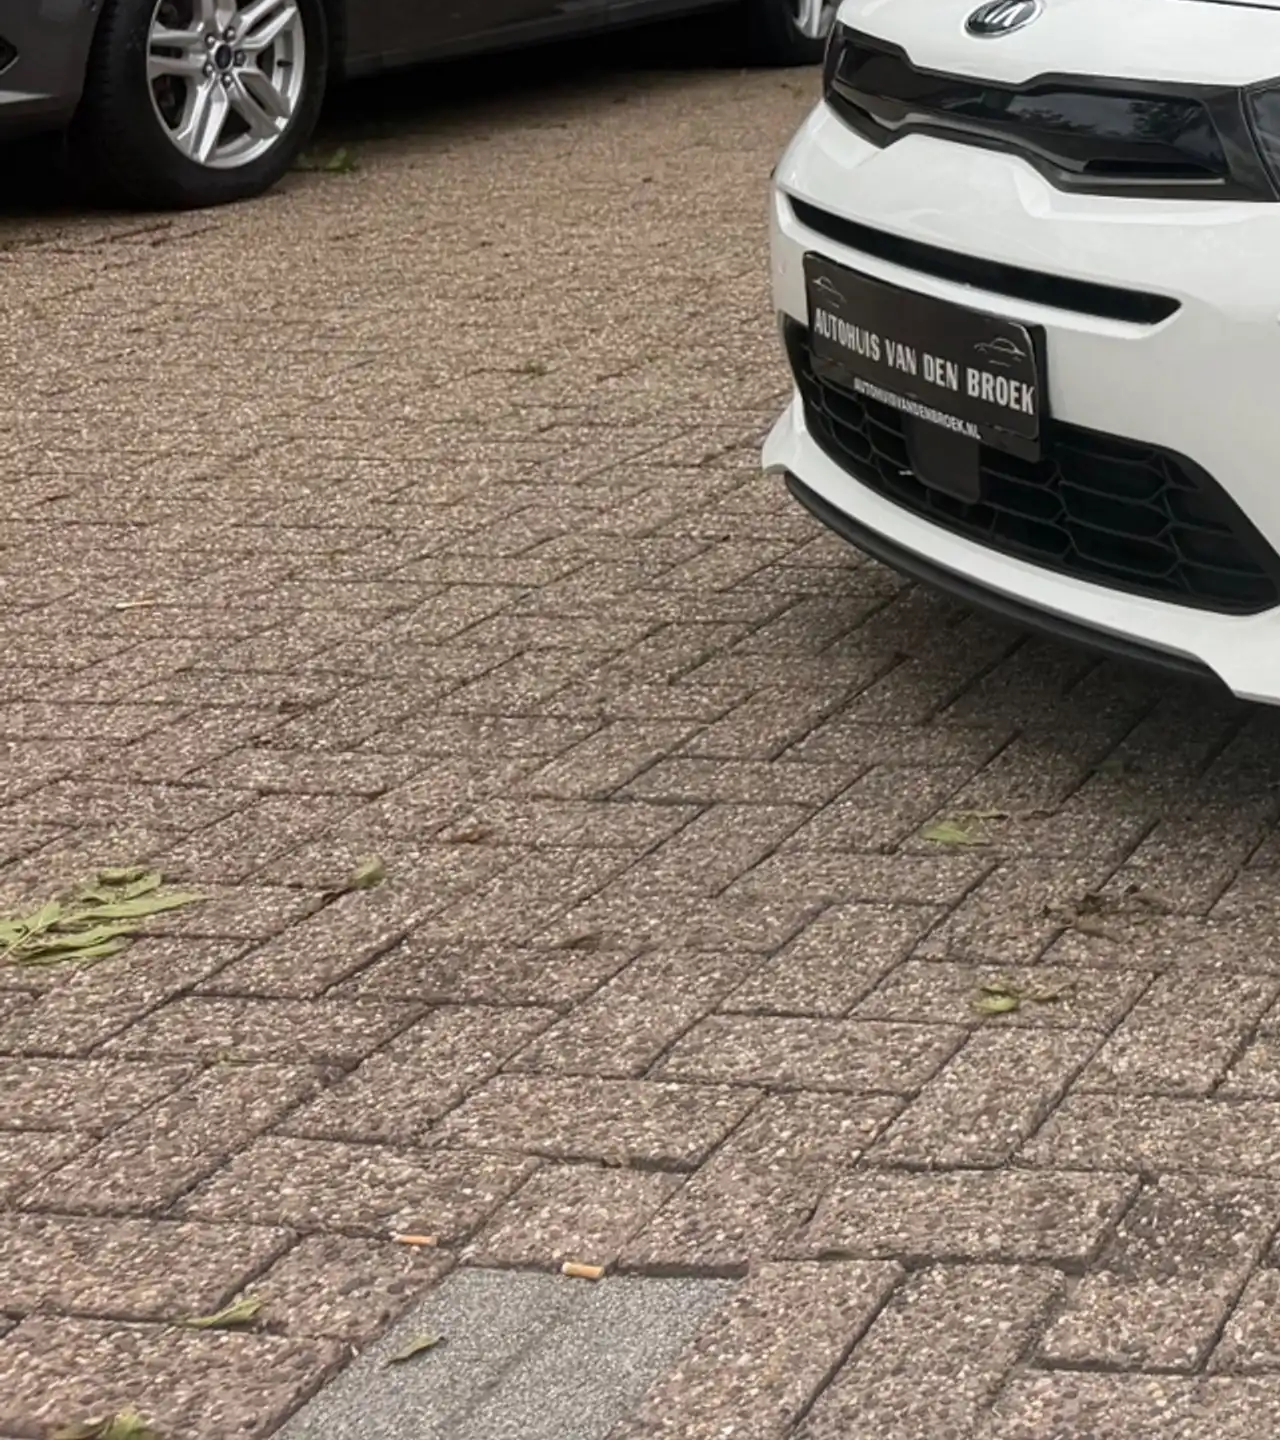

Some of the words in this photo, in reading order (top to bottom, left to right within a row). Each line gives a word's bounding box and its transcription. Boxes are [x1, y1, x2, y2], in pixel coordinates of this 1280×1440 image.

[813, 307, 880, 362] AUTOHUIS
[885, 338, 917, 376] VAN
[923, 353, 959, 392] DEN
[966, 367, 1036, 416] BROEK
